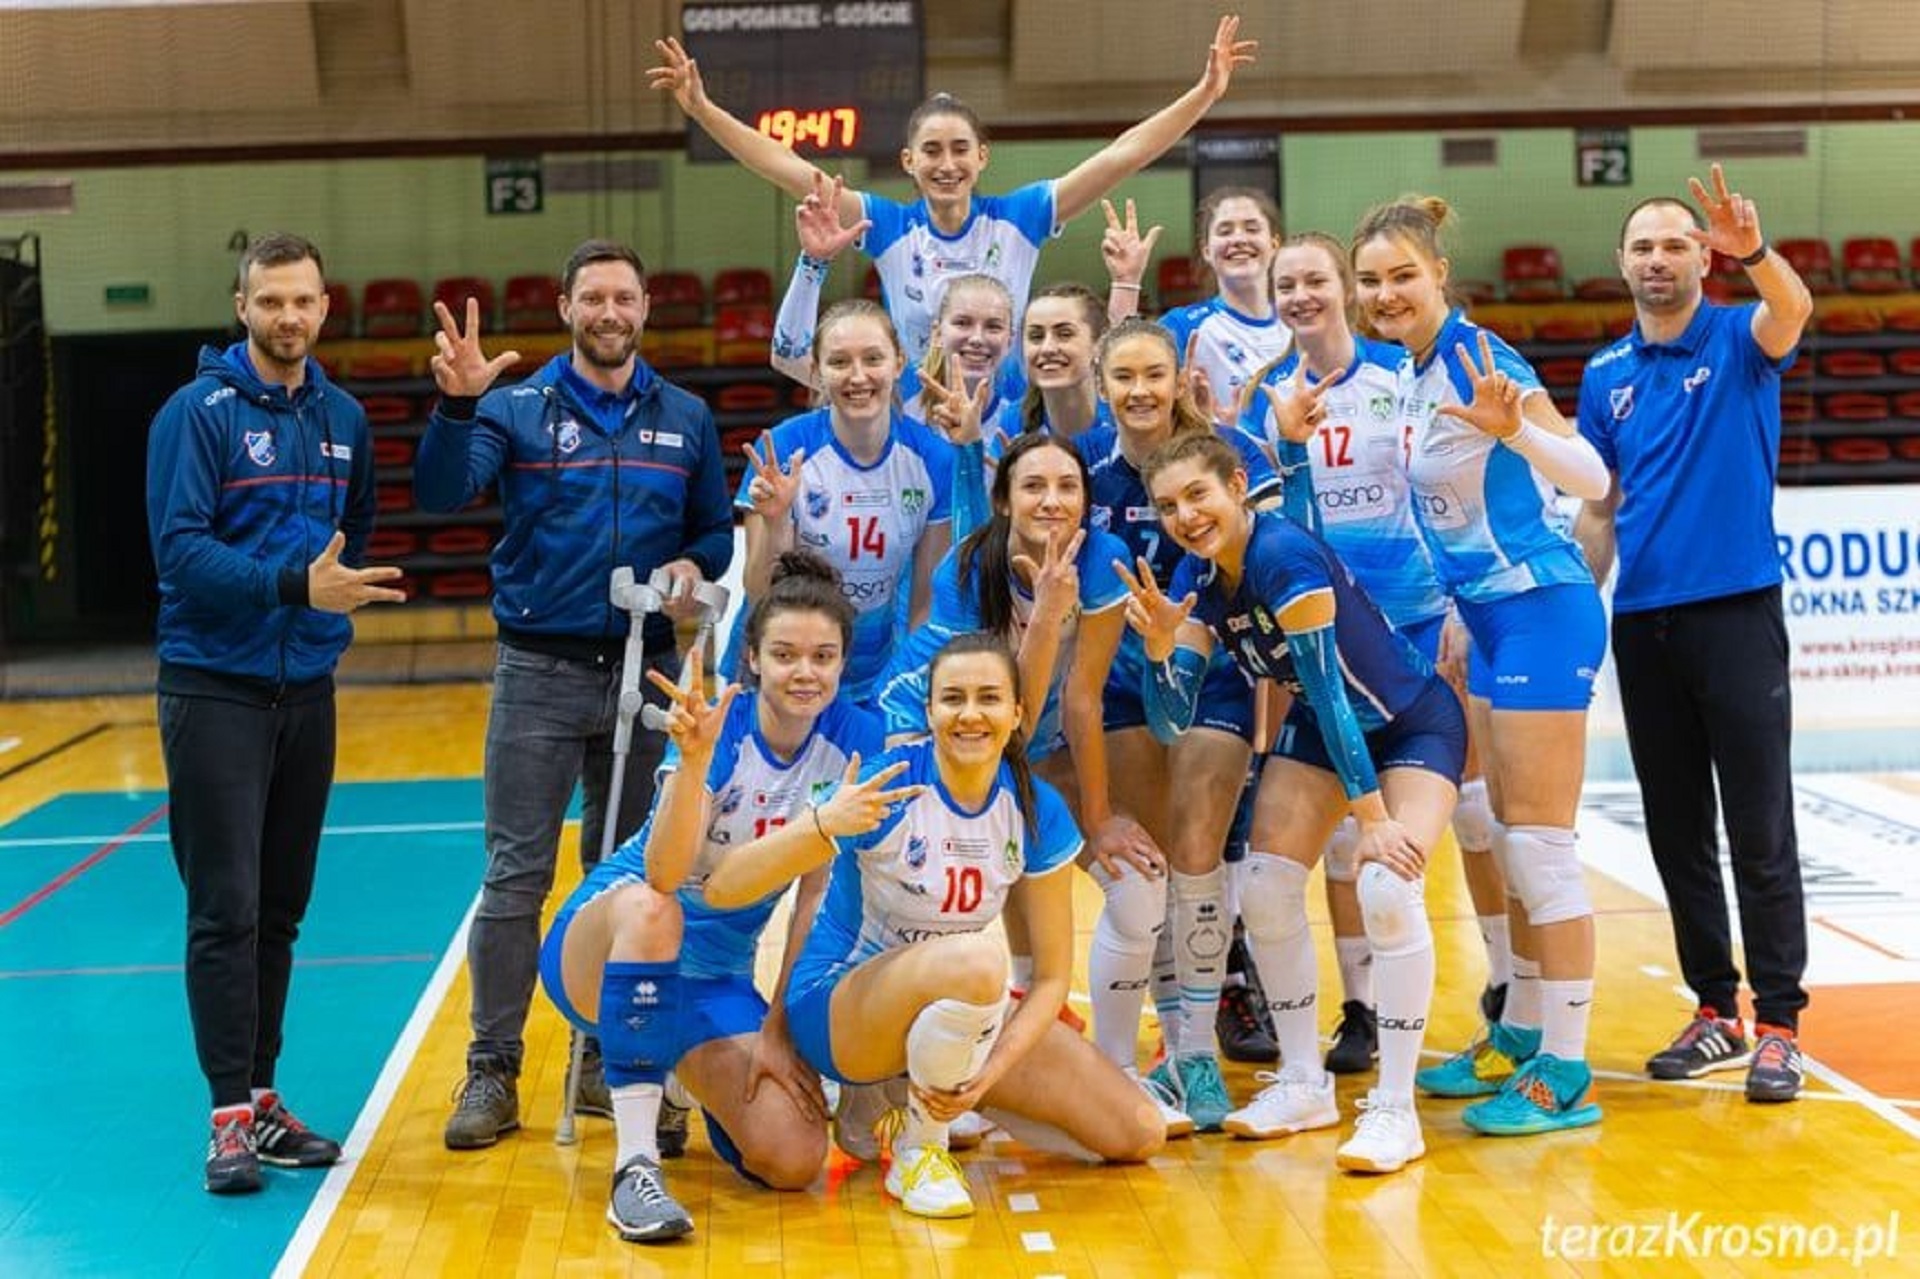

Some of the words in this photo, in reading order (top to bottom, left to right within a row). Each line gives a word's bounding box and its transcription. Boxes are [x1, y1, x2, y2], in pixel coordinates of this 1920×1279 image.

[758, 107, 857, 148] 19:47
[1581, 148, 1626, 181] F2
[491, 177, 538, 211] F3
[1319, 426, 1353, 467] 12
[1317, 484, 1384, 508] rosno
[847, 516, 885, 561] 14
[1140, 531, 1160, 560] 7
[941, 866, 982, 912] 10
